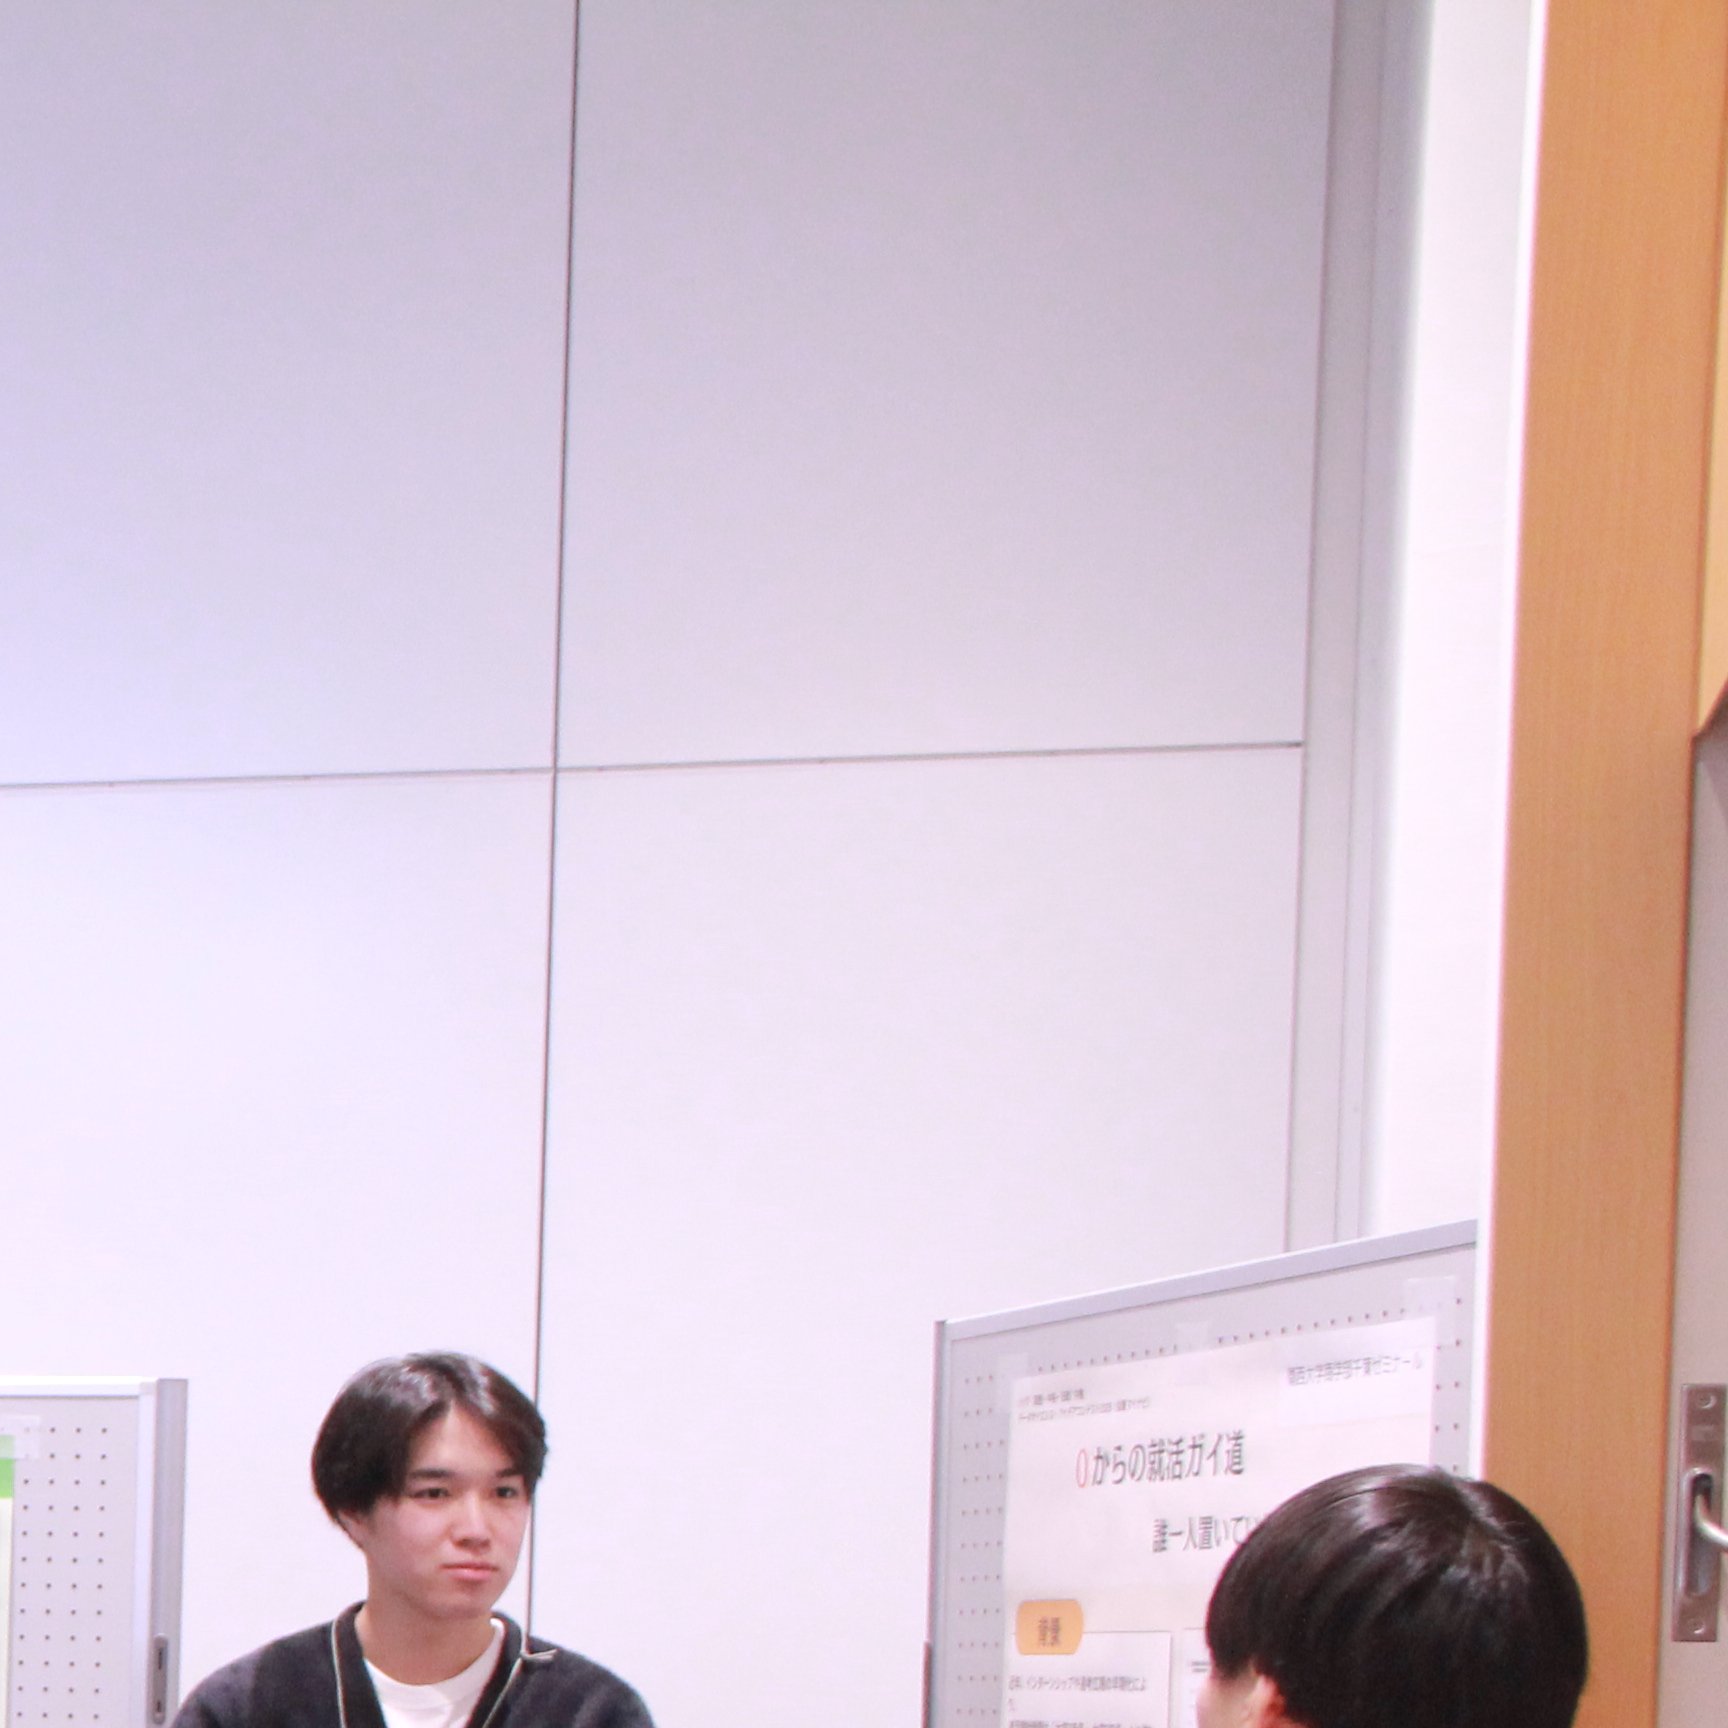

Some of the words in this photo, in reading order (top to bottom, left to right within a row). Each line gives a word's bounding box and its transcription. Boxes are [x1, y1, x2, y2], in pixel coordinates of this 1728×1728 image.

[1076, 1430, 1245, 1488] 0からの就活ガイ道
